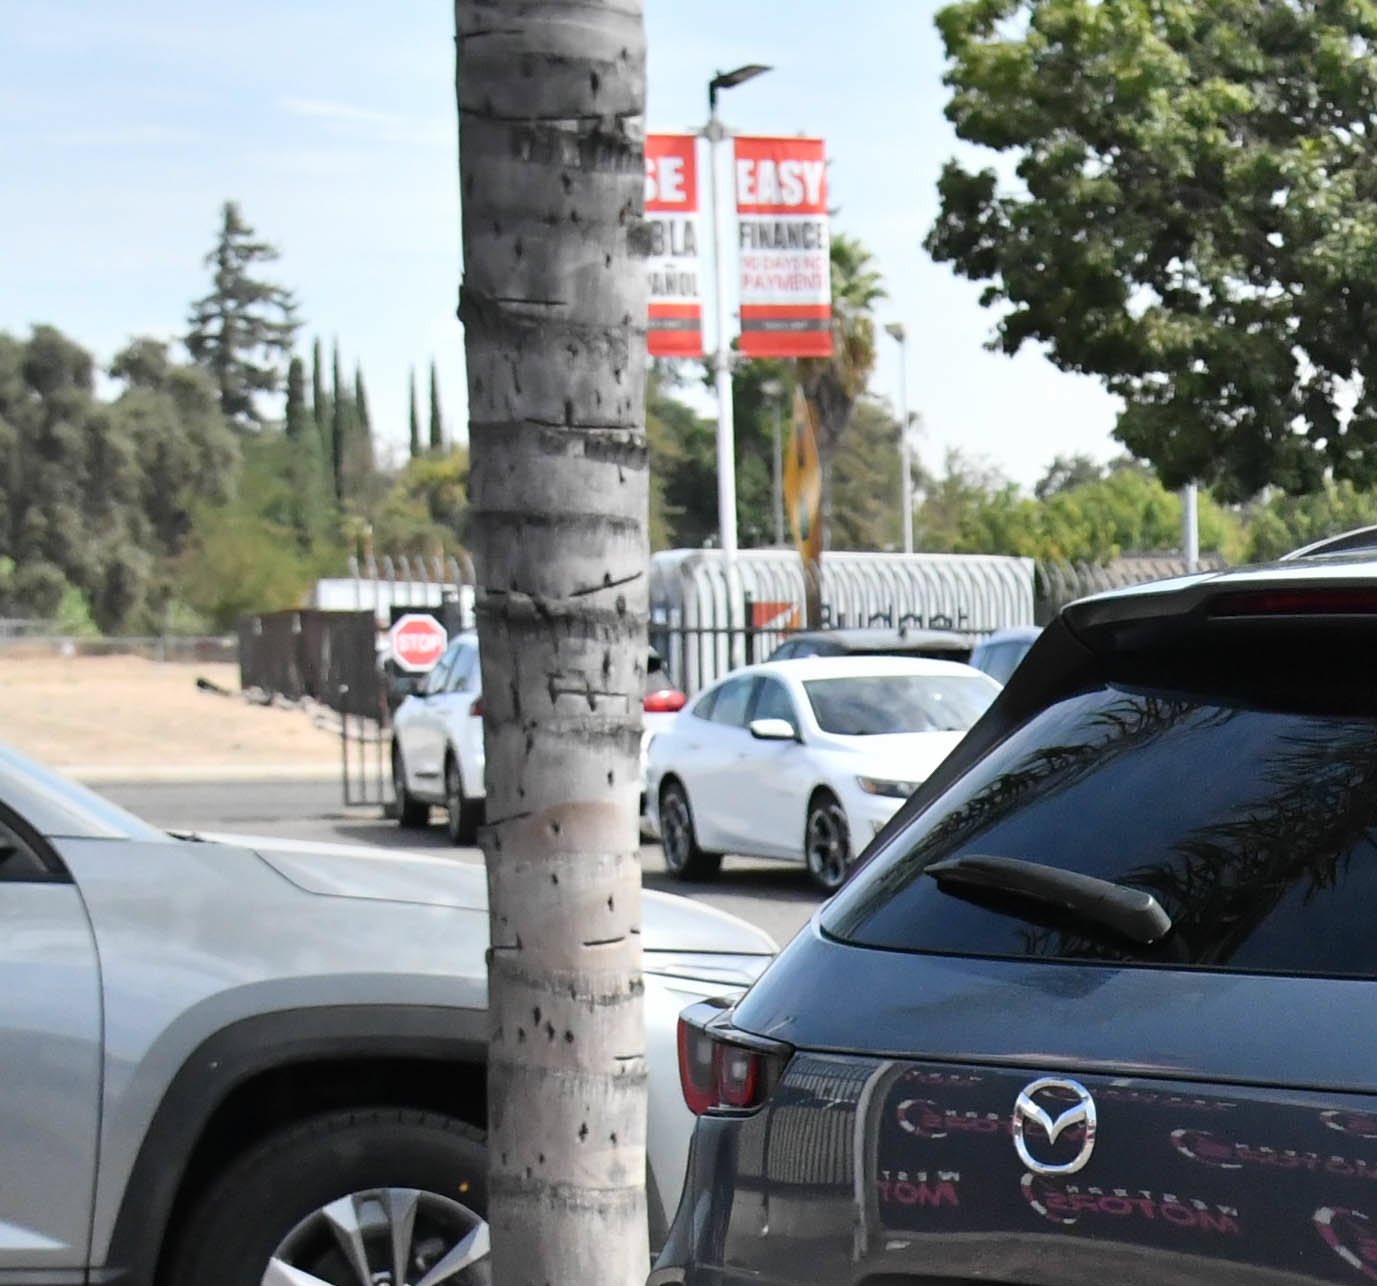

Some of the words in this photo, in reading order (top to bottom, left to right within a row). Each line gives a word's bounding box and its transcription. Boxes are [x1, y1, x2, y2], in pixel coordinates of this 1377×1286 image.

[736, 158, 824, 206] EASY
[739, 221, 824, 250] FINANCE
[399, 633, 442, 653] STOP
